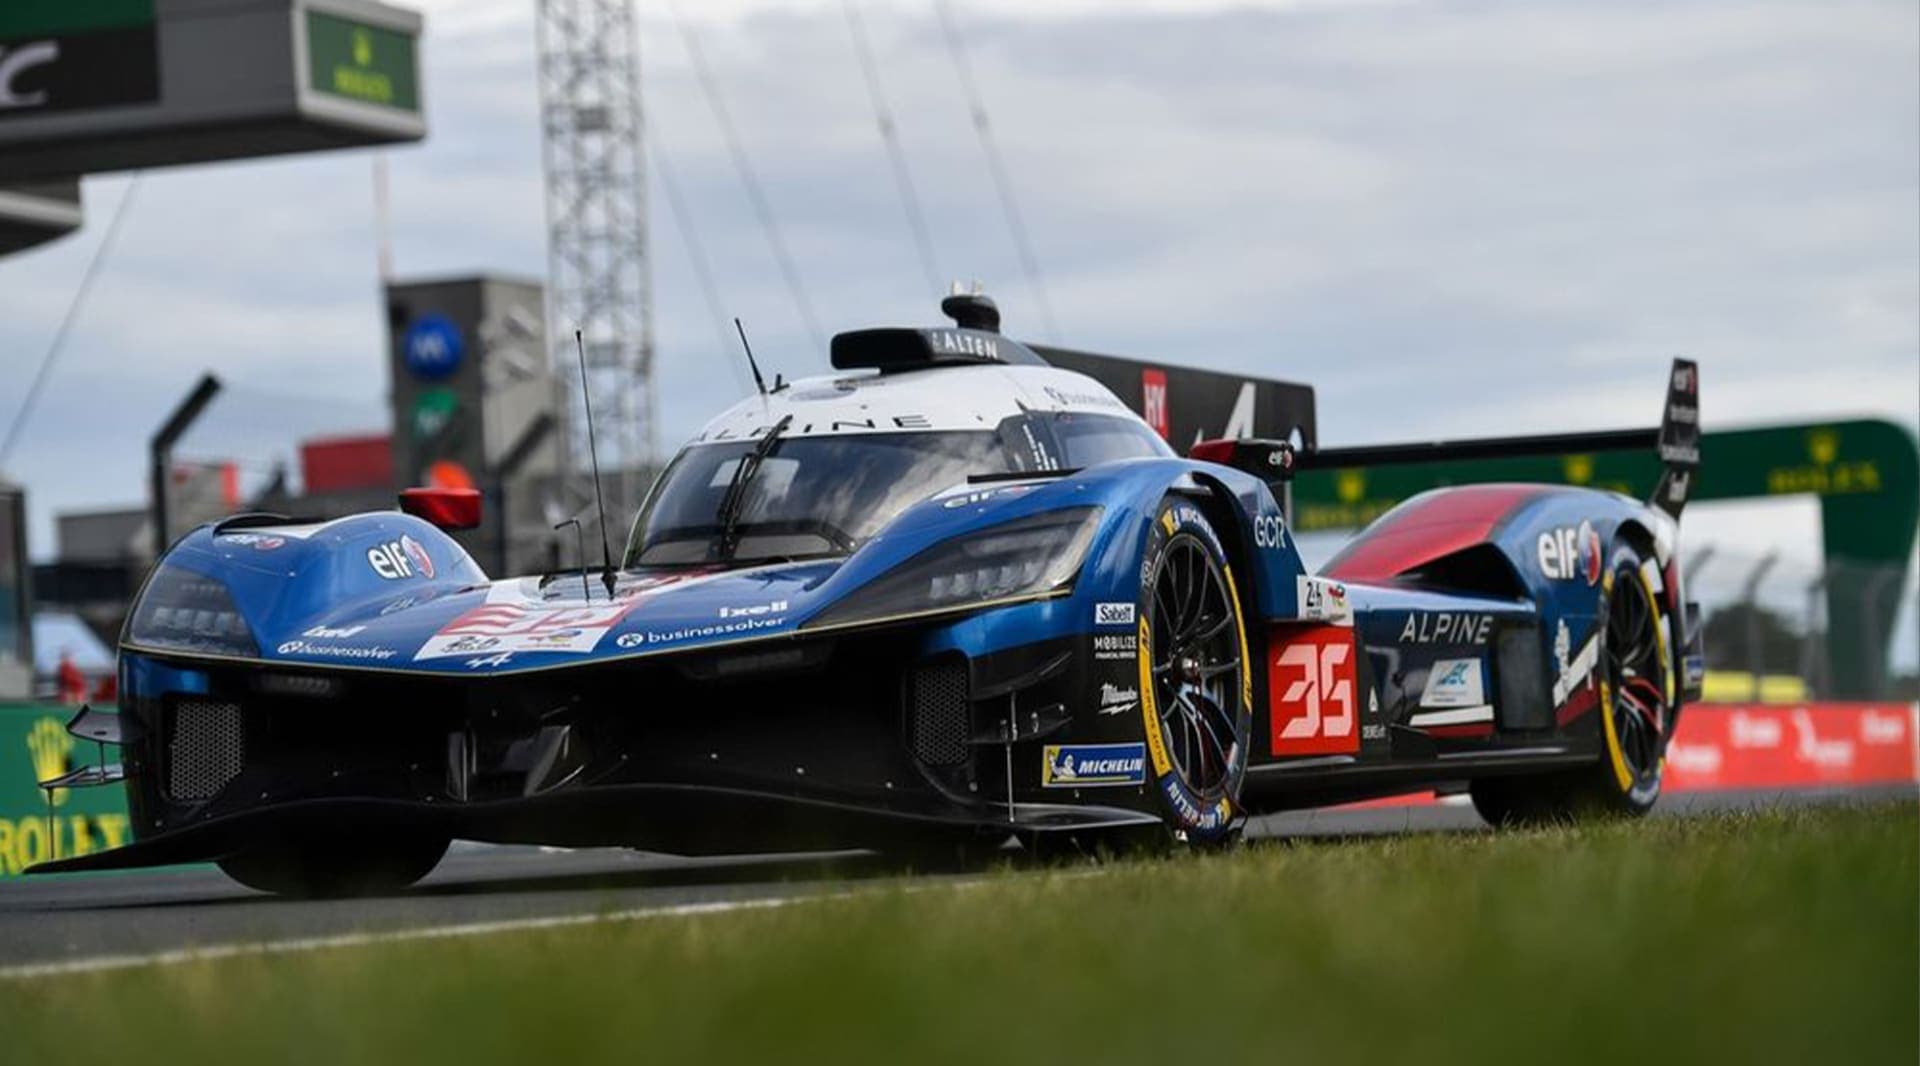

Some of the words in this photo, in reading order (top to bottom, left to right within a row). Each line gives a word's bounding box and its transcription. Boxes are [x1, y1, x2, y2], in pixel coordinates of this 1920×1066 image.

[944, 332, 998, 359] ALTEN
[1254, 516, 1287, 549] GCR
[368, 541, 412, 579] elf
[1539, 528, 1578, 579] elf
[1100, 605, 1132, 621] Sabelt
[647, 616, 786, 644] businessolver
[1094, 636, 1137, 650] MOBILIZE
[1400, 612, 1494, 645] ALPINE
[1276, 644, 1353, 740] 35
[1079, 758, 1143, 774] MICHELIN
